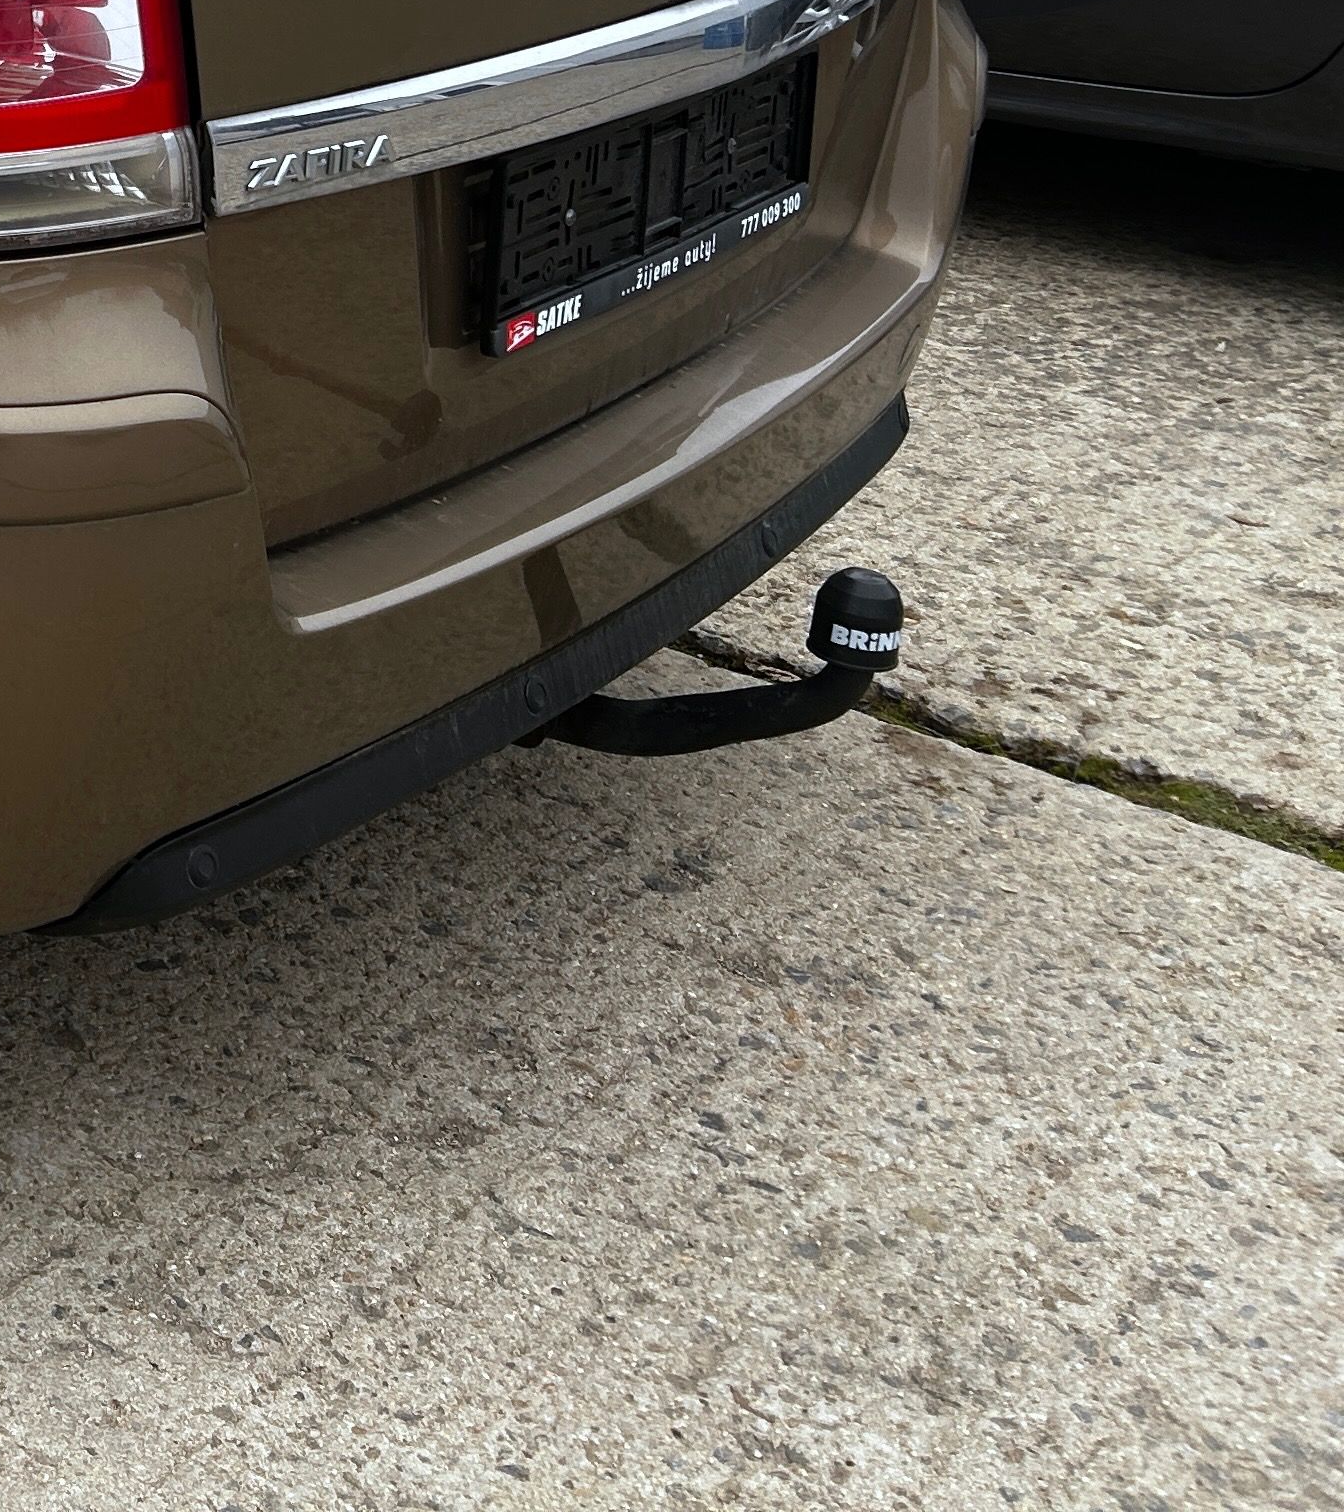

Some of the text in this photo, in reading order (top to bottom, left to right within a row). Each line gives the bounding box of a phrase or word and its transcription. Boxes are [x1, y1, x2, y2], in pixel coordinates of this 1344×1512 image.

[247, 134, 396, 190] ZAFIRA
[740, 192, 802, 238] 777 009 300
[685, 232, 717, 267] auty!
[536, 293, 583, 337] SATKE
